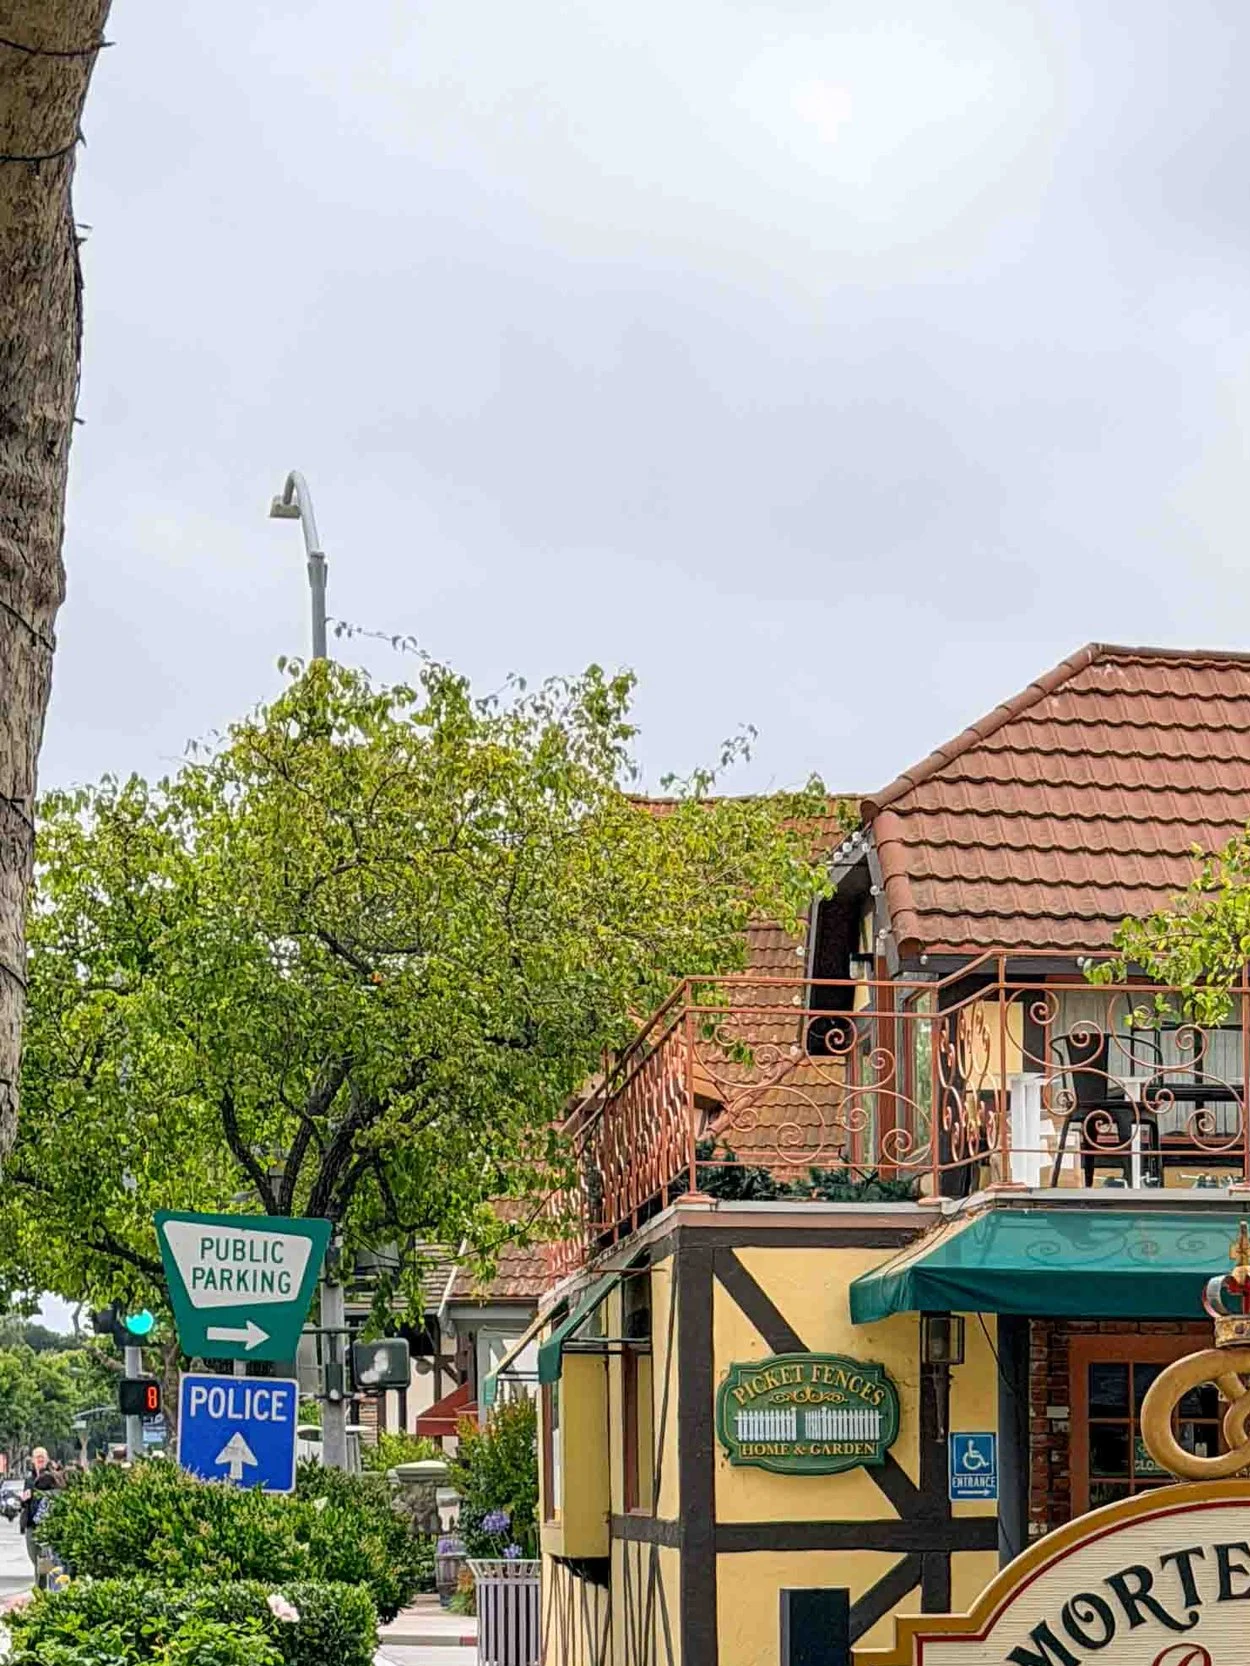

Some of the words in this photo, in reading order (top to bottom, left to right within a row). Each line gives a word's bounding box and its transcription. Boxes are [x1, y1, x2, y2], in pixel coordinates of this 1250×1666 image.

[200, 1236, 284, 1264] PUBLIC
[191, 1267, 291, 1294] PARKING
[732, 1364, 804, 1405] PICKET
[811, 1364, 886, 1406] FENCES
[190, 1386, 287, 1421] POLICE
[742, 1442, 790, 1456] HOME
[793, 1443, 806, 1455] &
[810, 1441, 876, 1455] GARDEN
[952, 1476, 996, 1488] ENTRANCE
